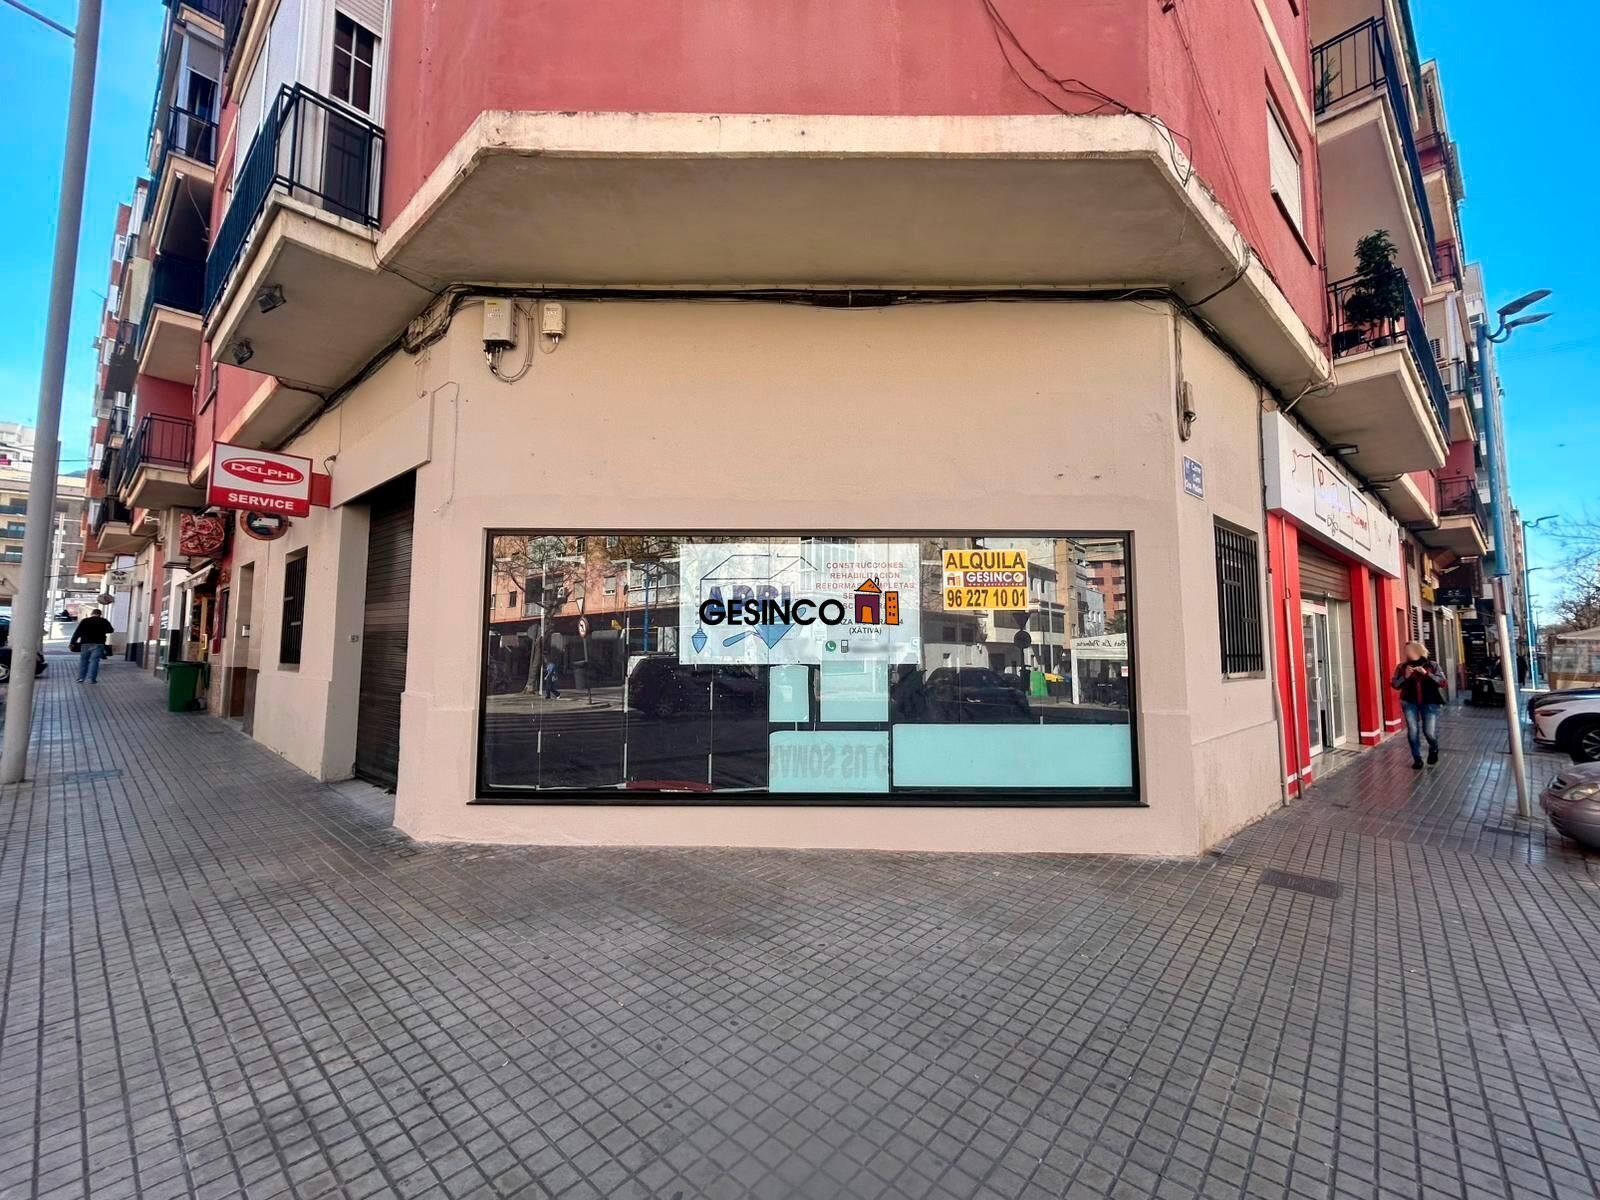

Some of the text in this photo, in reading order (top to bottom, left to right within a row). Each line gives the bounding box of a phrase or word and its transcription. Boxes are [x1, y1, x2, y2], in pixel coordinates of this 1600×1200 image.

[230, 462, 295, 480] DELPHI
[228, 492, 294, 510] SERVICE
[946, 552, 1026, 570] ALQUILA
[966, 572, 1024, 582] GESINCO
[947, 589, 1026, 607] 96 227 10 01
